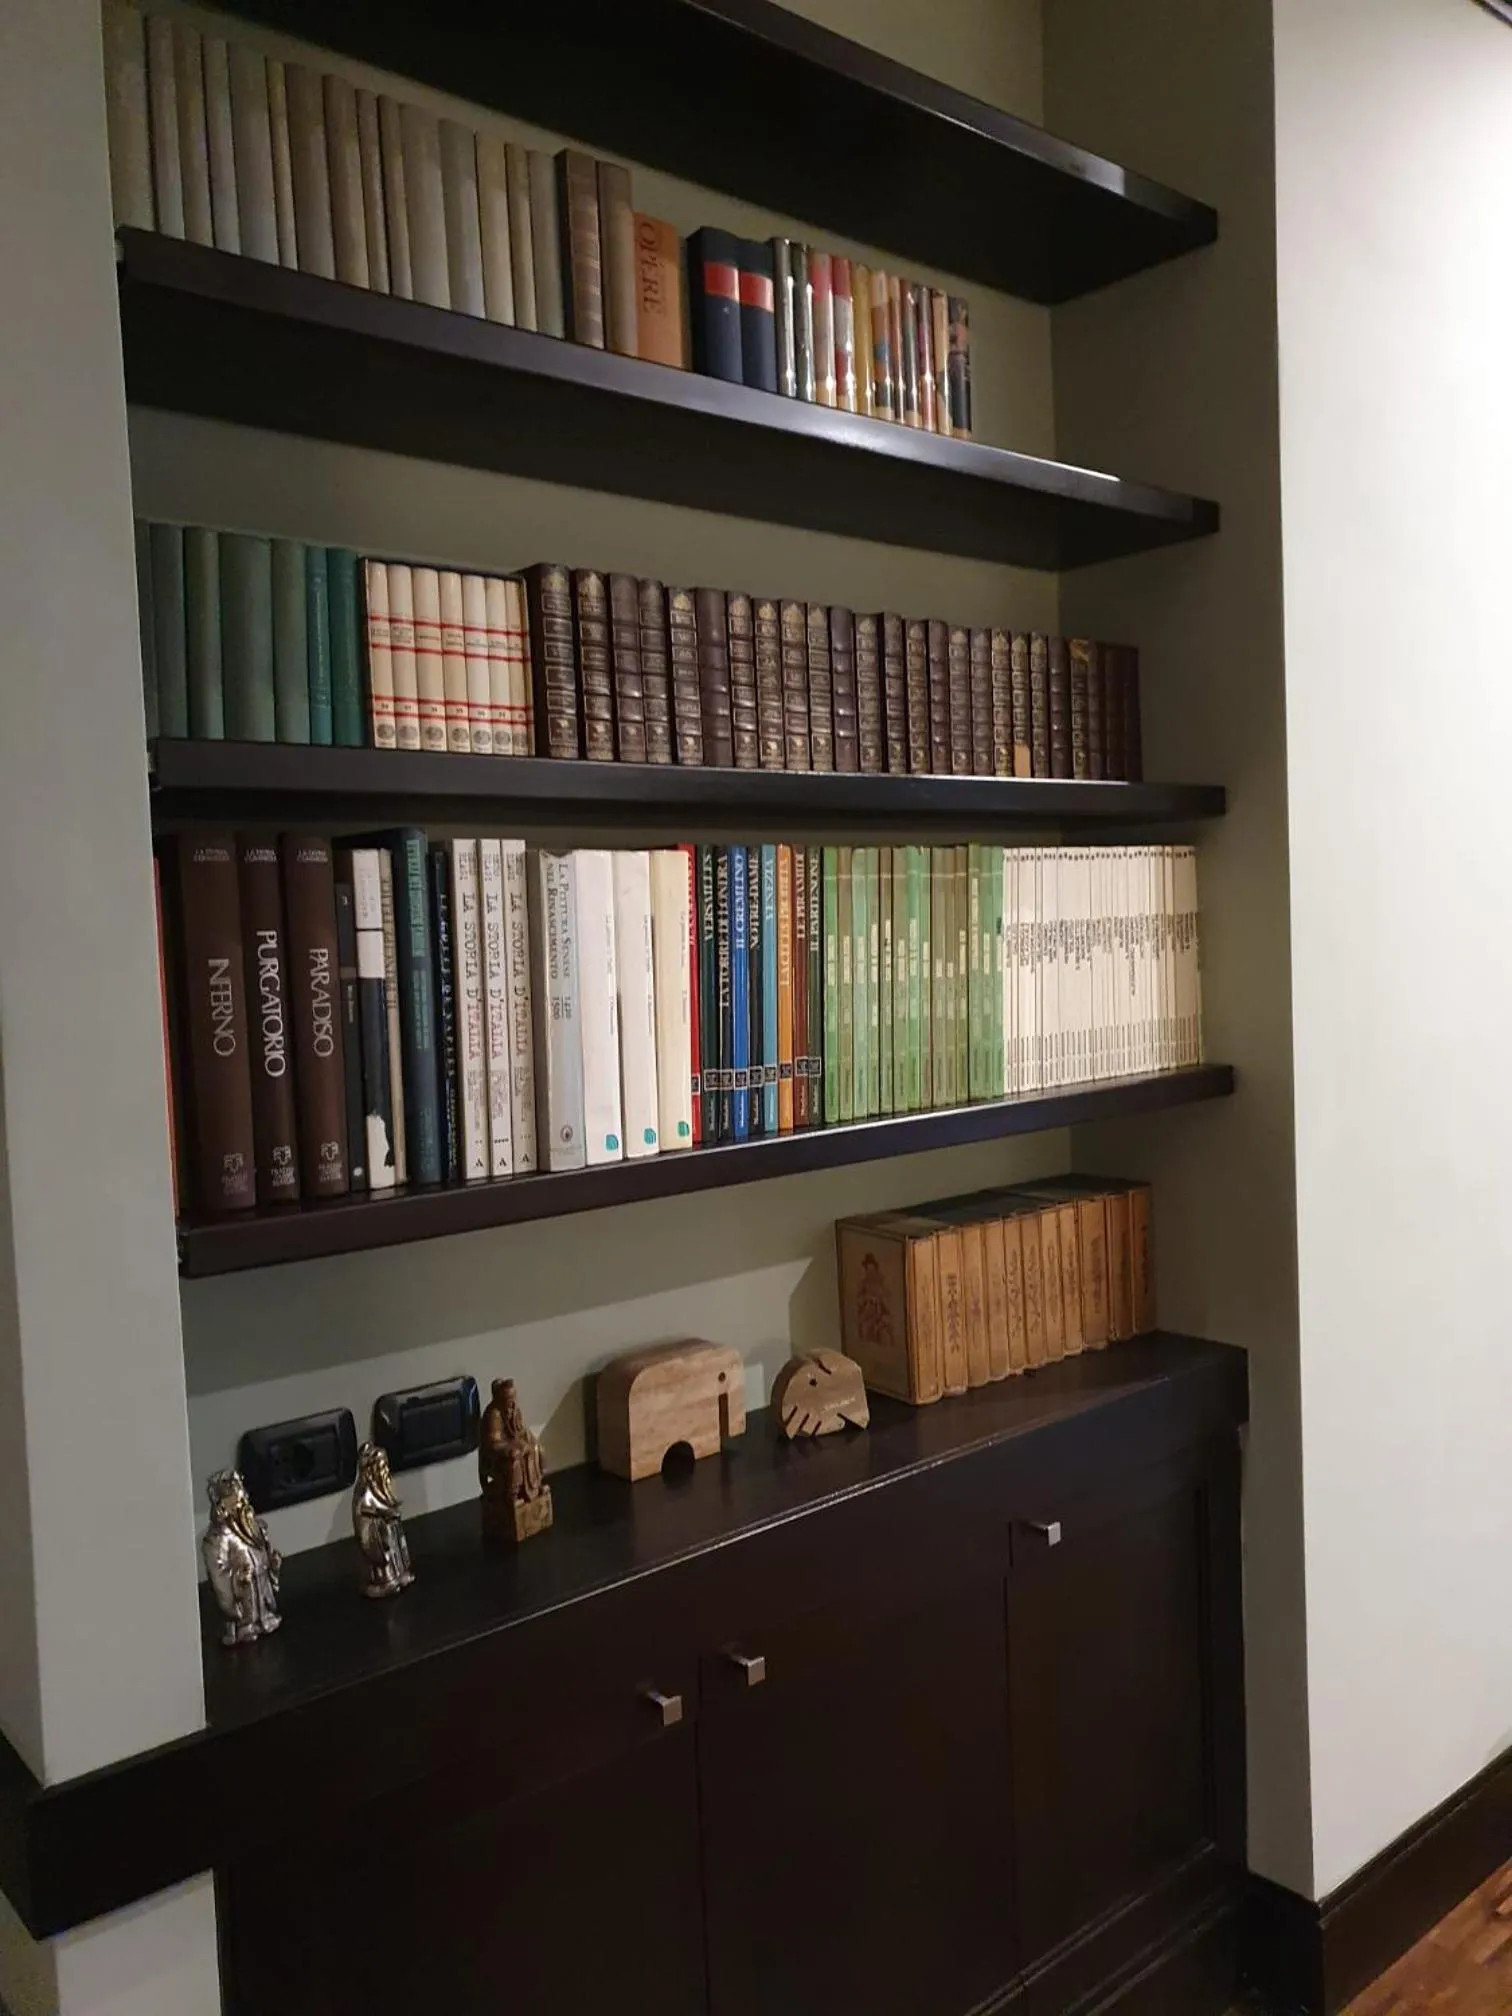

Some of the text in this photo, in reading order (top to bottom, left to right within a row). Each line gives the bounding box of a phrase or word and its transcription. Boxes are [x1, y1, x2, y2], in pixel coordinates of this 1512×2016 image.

[462, 892, 476, 913] LA
[486, 892, 498, 914] LA
[510, 892, 522, 913] LA
[702, 853, 714, 941] VERSAILLES
[735, 854, 745, 934] CREMLINO
[748, 854, 760, 949] NOTRE-DAME
[765, 859, 774, 921] VENEZIA
[795, 853, 805, 917] PIRAMIDI
[809, 854, 819, 935] PARTENONE
[464, 921, 478, 979] STORIA
[487, 921, 501, 979] STORIA
[511, 921, 525, 979] STORIA
[256, 929, 286, 1078] PURGATORIO
[309, 948, 334, 1058] PARADISO
[466, 988, 482, 1060] D'ITALIA
[490, 988, 504, 1060] D'ITALIA
[514, 986, 529, 1057] D'ITALIA
